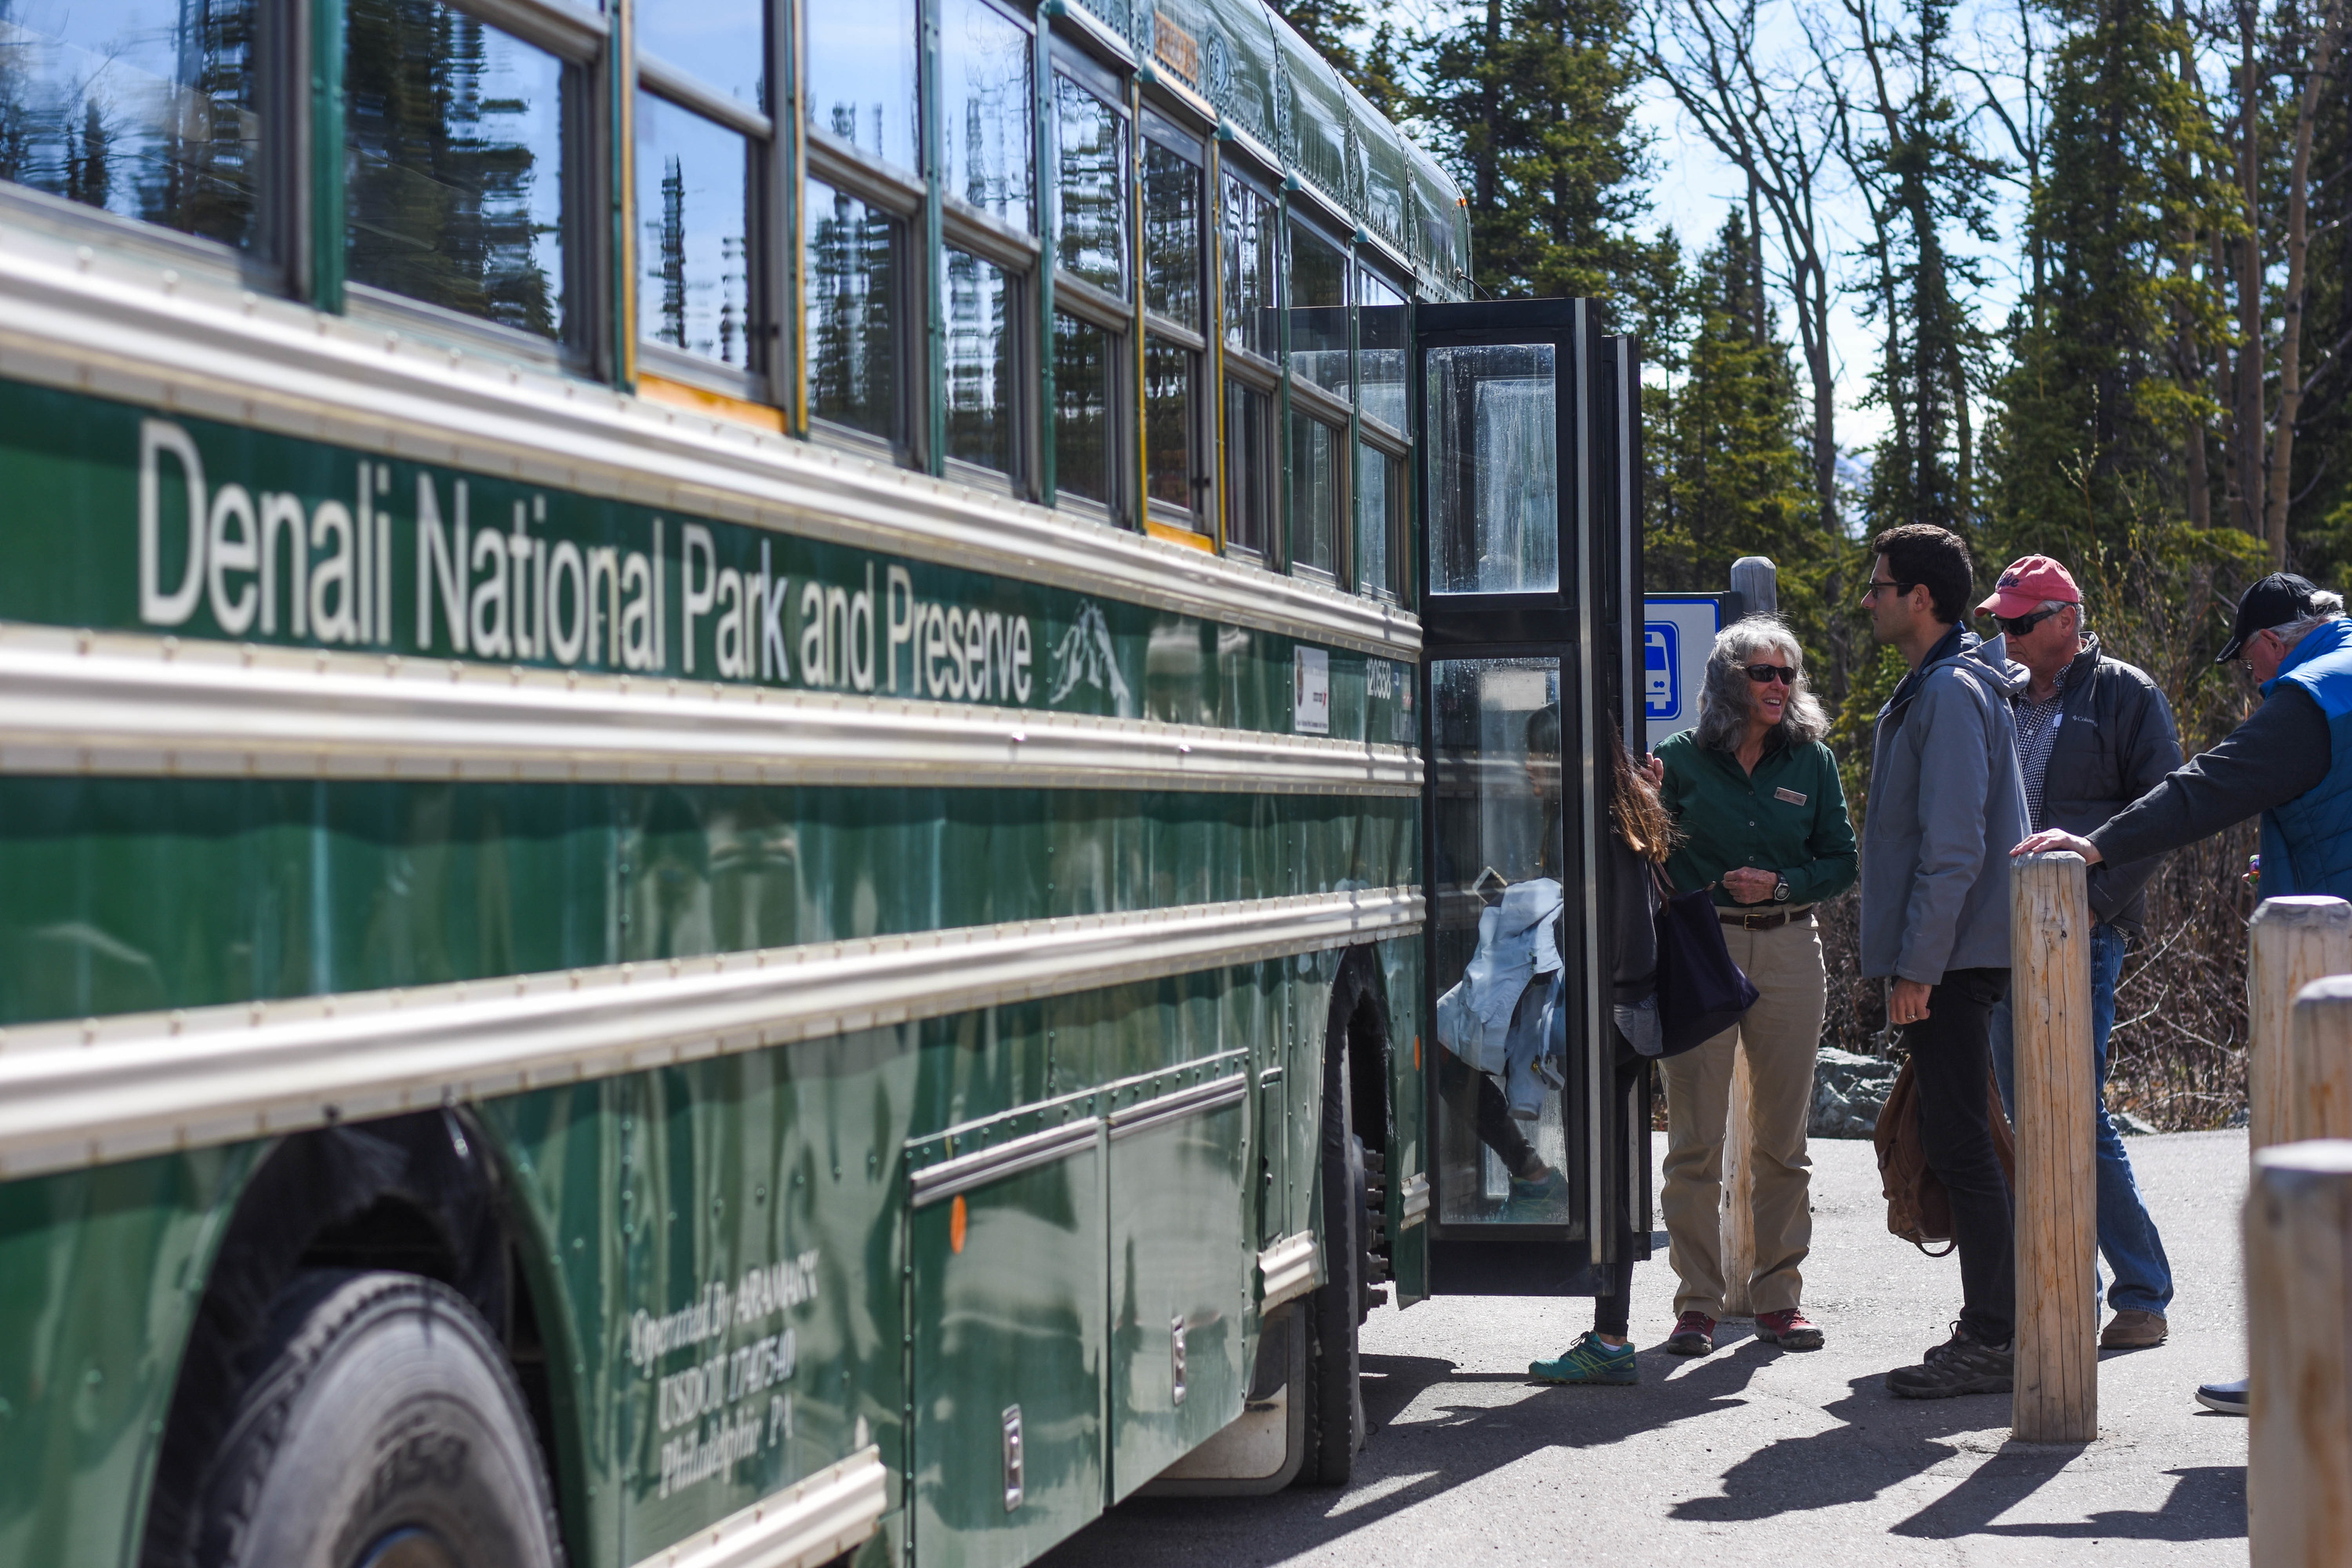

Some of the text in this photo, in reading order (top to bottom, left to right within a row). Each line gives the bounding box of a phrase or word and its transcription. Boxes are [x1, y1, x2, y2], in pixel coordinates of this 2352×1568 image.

[140, 419, 1033, 703] Denali National Park and Preserve
[1367, 657, 1391, 699] 120558
